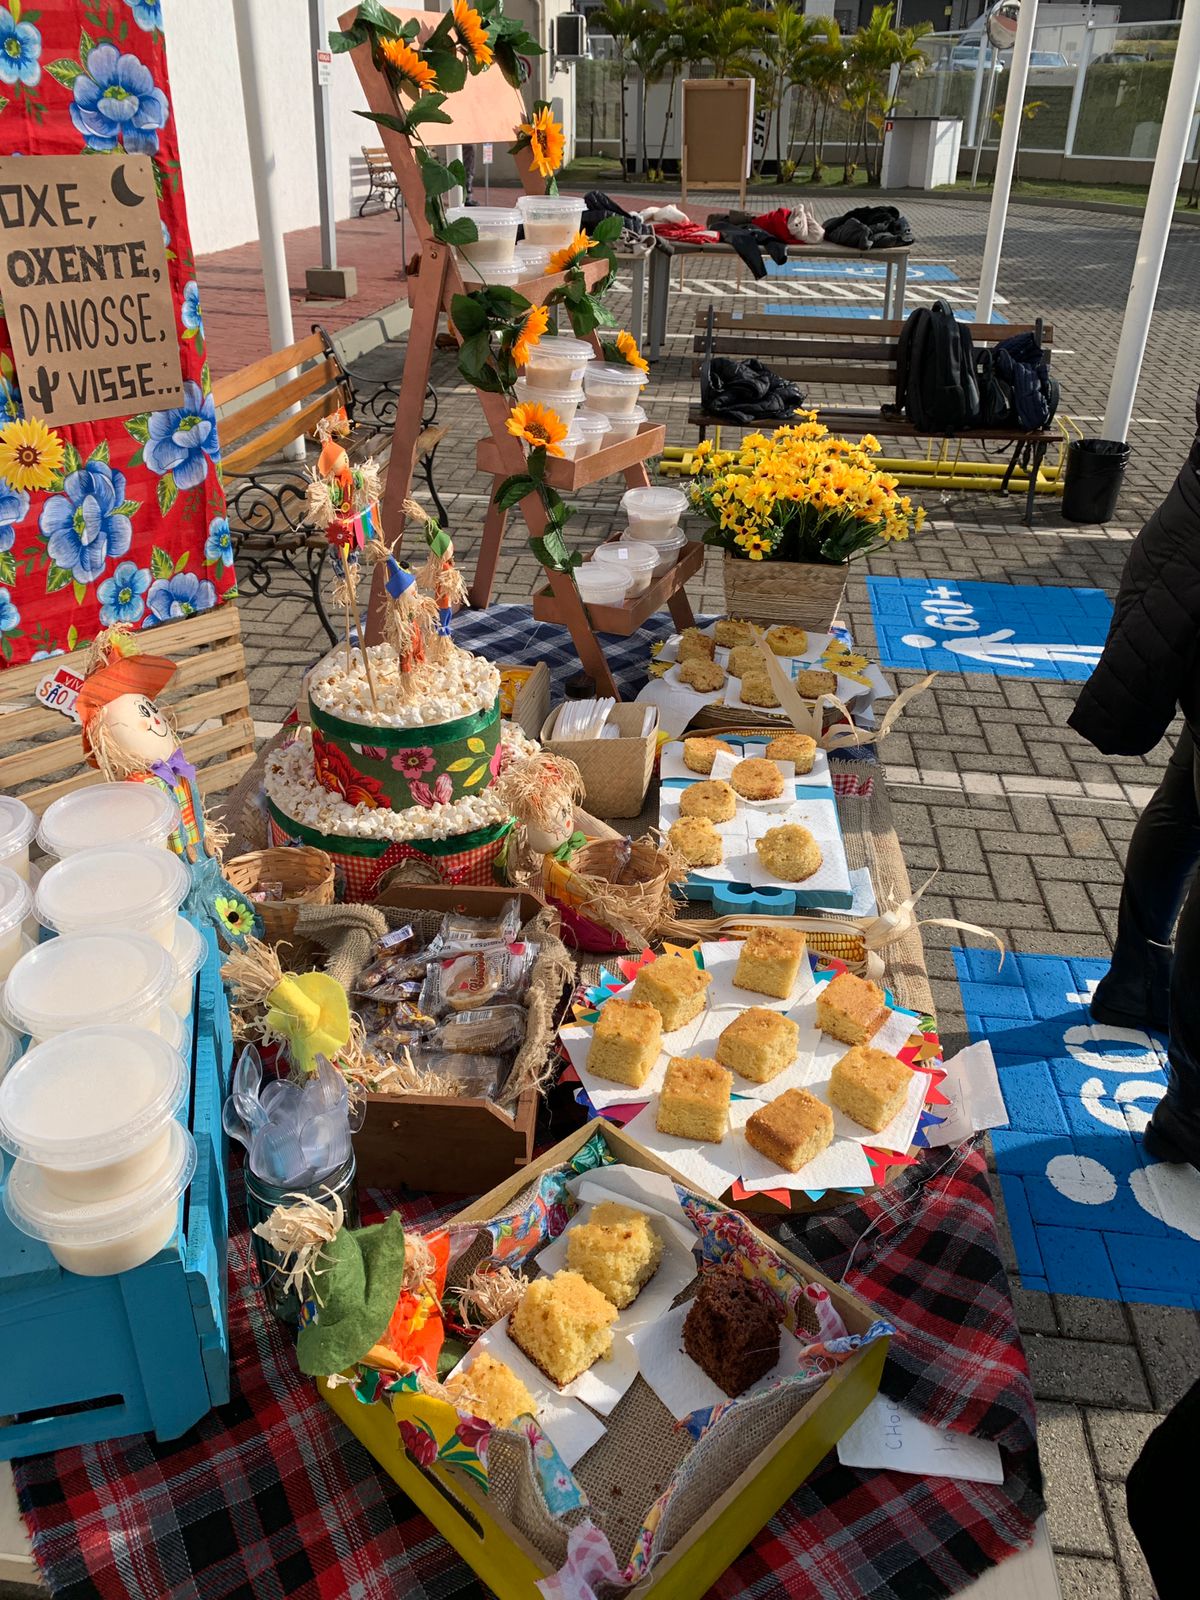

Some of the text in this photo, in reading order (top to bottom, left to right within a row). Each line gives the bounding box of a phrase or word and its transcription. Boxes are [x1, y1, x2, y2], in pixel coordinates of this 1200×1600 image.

[0, 184, 97, 229] OXE,
[7, 240, 160, 287] OXENTE,
[20, 293, 165, 356] DANOSSE,
[68, 362, 181, 405] VISSE...
[921, 586, 980, 631] 60+
[40, 681, 68, 705] SÃO
[65, 676, 83, 691] VIV
